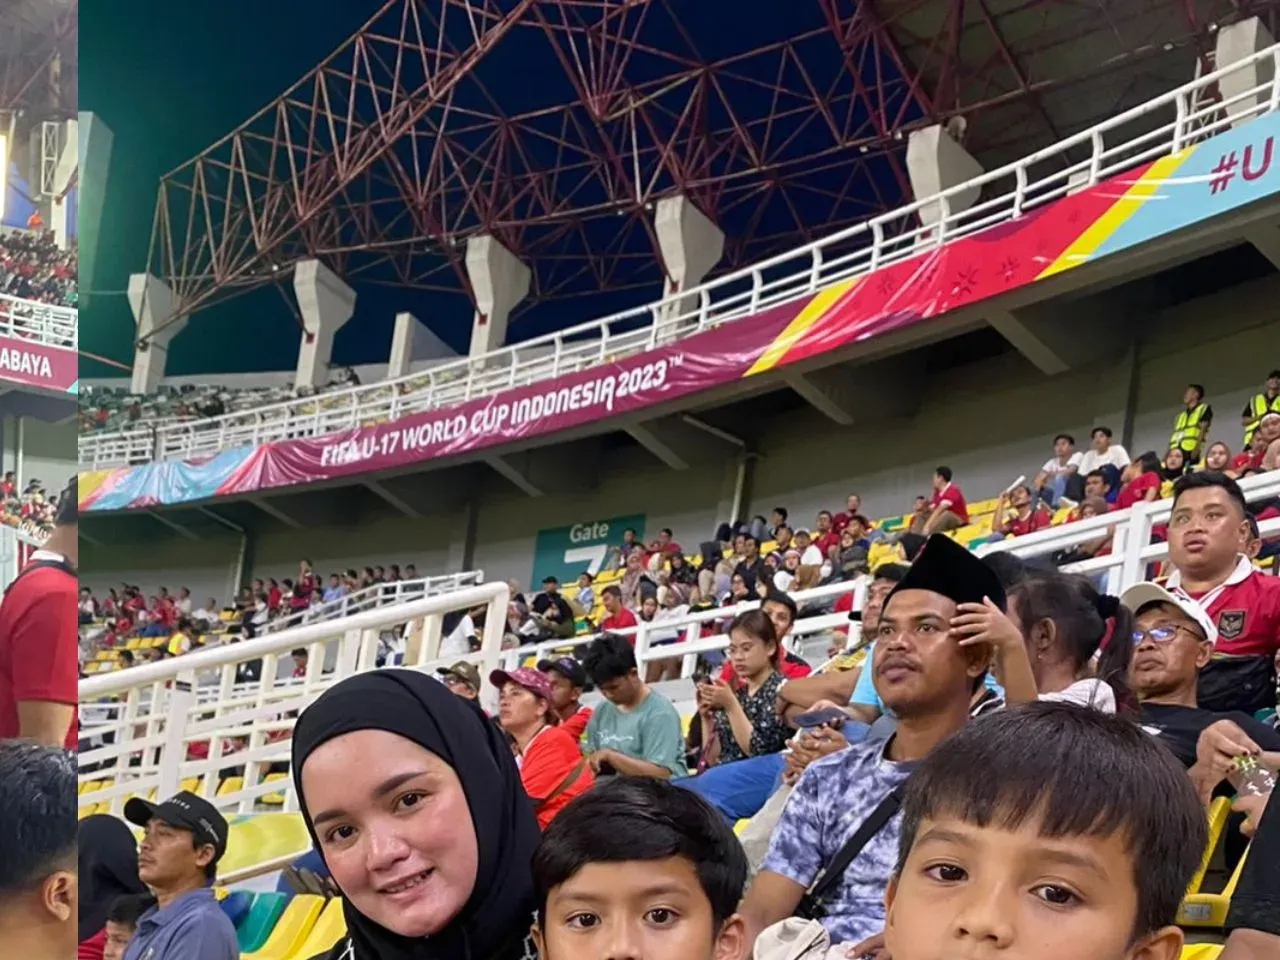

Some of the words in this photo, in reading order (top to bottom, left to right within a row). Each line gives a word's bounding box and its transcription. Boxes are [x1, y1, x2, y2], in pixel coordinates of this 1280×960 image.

[320, 439, 361, 467] FIFA
[362, 429, 401, 459] U-17
[402, 414, 468, 450] WORLD
[470, 403, 509, 434] CUP
[510, 375, 617, 424] INDONESIA
[569, 522, 609, 543] Gate
[563, 544, 608, 577] 7
